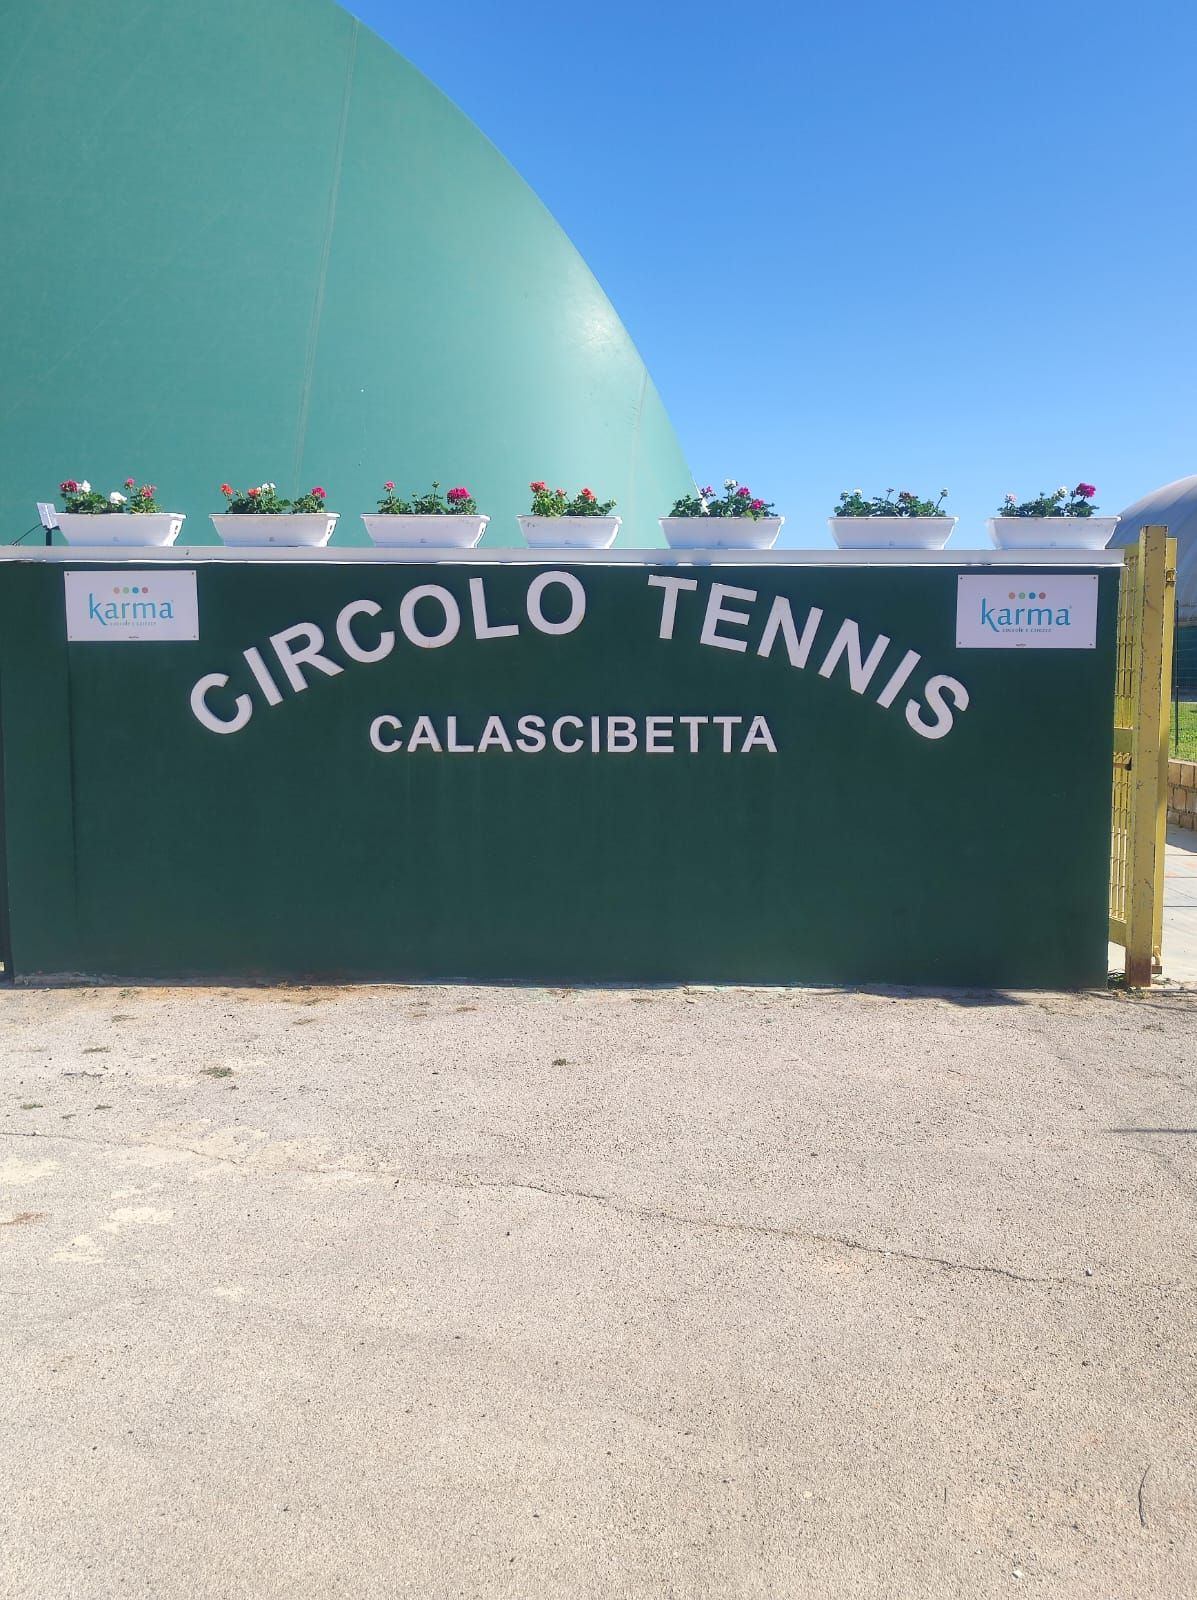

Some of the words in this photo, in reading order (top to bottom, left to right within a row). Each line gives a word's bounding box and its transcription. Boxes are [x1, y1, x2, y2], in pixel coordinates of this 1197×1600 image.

[88, 592, 174, 626] karma
[981, 597, 1071, 633] karma
[190, 570, 587, 734] CIRCOLO
[647, 574, 970, 740] TENNIS
[369, 715, 778, 754] CALASCIBETTA
